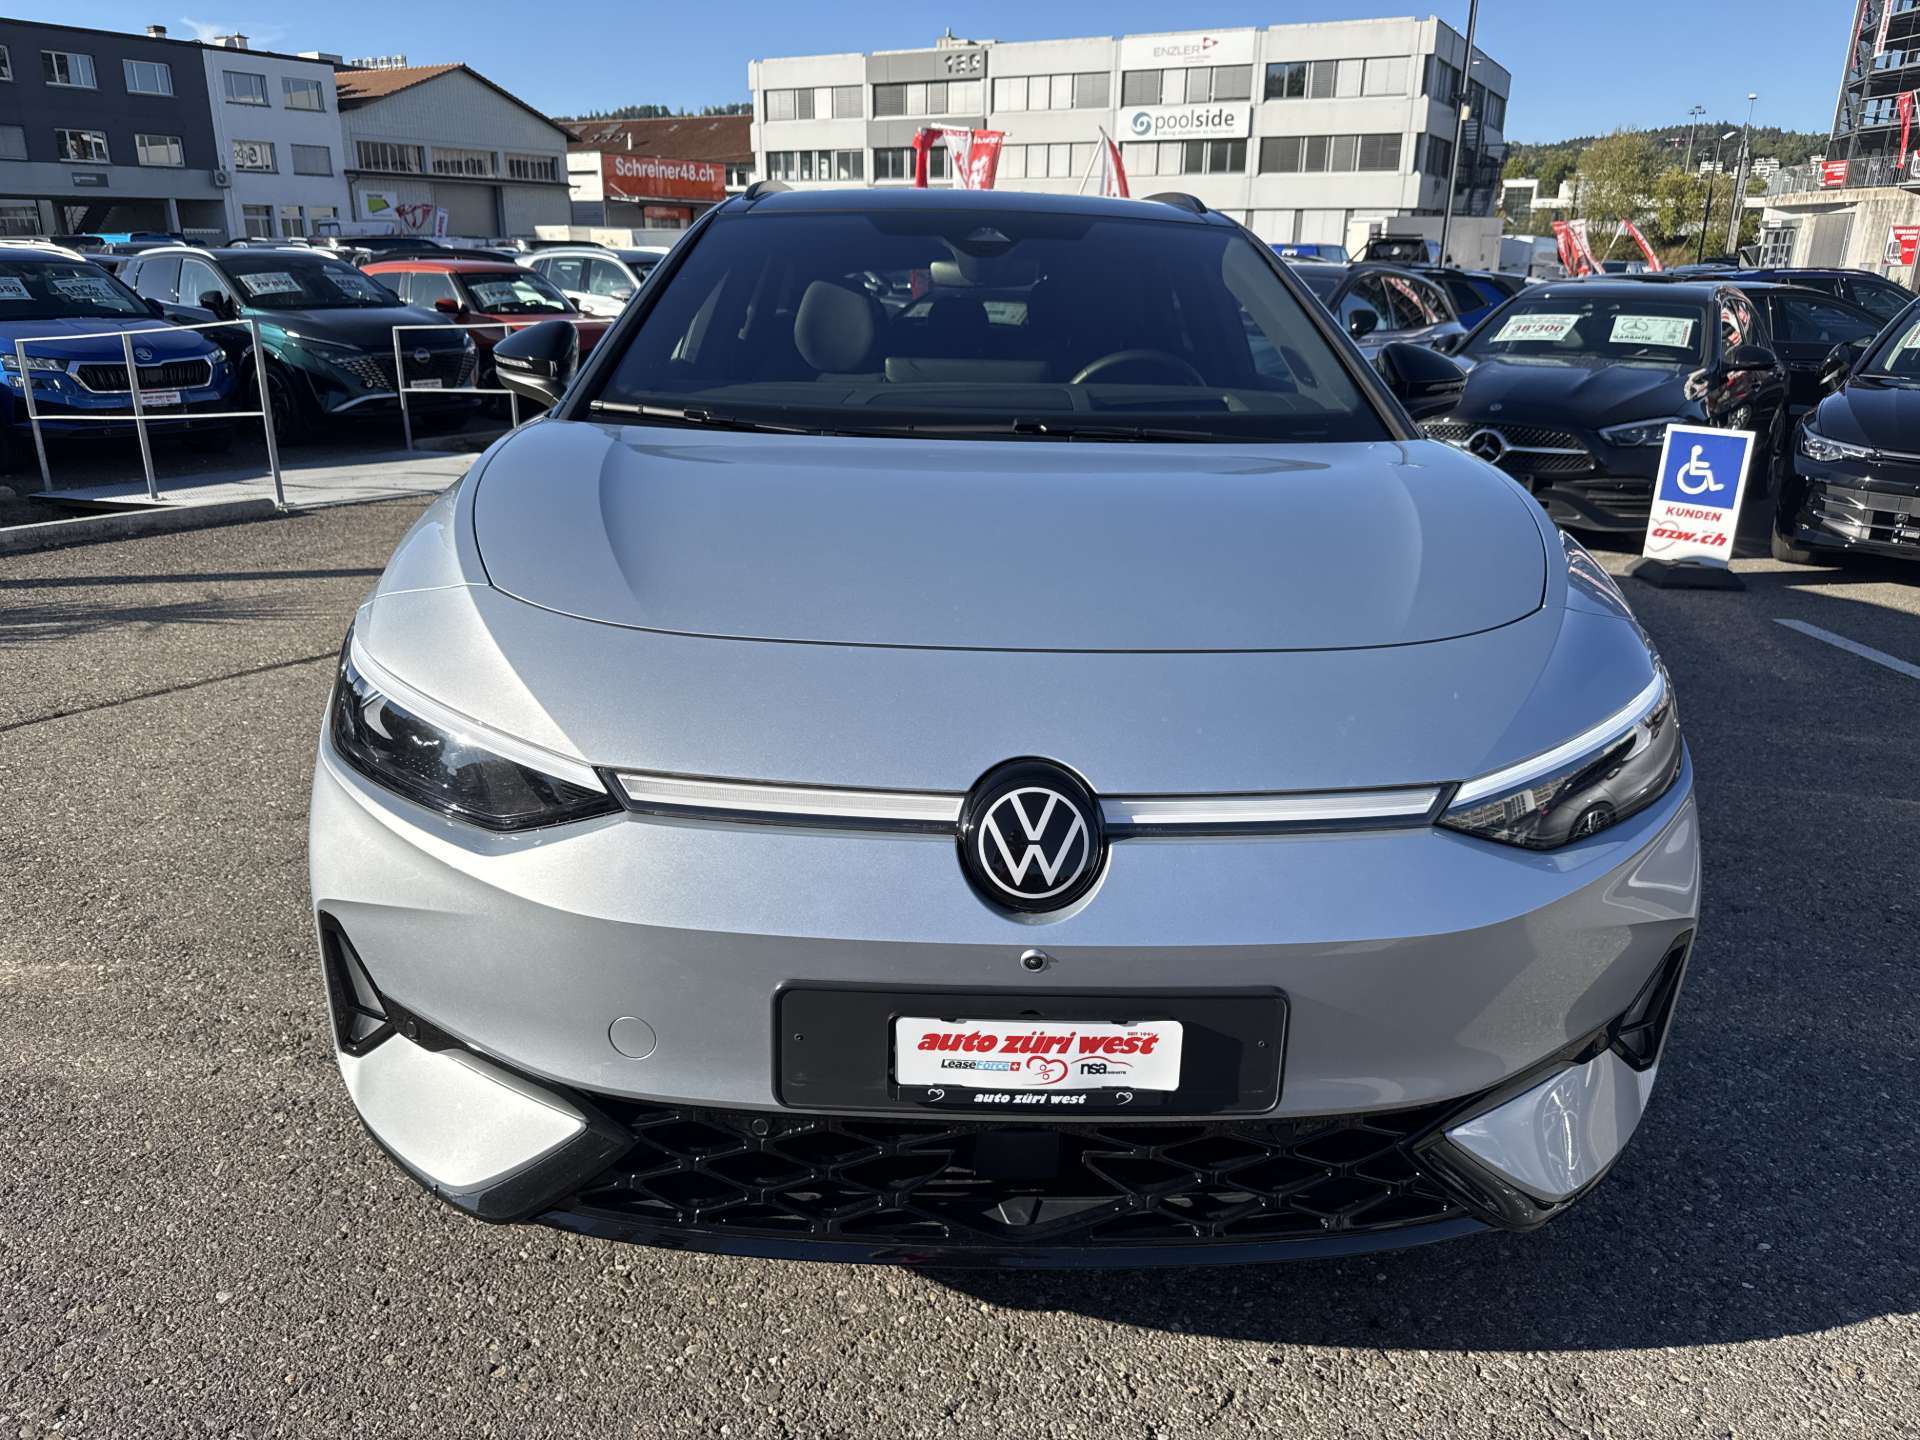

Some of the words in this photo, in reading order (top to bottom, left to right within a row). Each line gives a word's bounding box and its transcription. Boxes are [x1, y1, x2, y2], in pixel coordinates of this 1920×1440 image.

[1153, 45, 1200, 57] ENZLER
[944, 53, 980, 74] 139
[1155, 108, 1235, 136] poolside
[615, 157, 715, 182] Schreiner48.ch
[1666, 506, 1722, 521] KUNDEN
[1652, 528, 1728, 546] azw.ch
[917, 1031, 998, 1051] auto
[998, 1031, 1077, 1054] züri
[1079, 1034, 1160, 1055] west
[940, 1058, 1009, 1071] LeaseForce
[1080, 1063, 1107, 1075] nsa
[973, 1092, 1010, 1104] auto
[1012, 1092, 1046, 1104] züri
[1050, 1093, 1087, 1104] west
